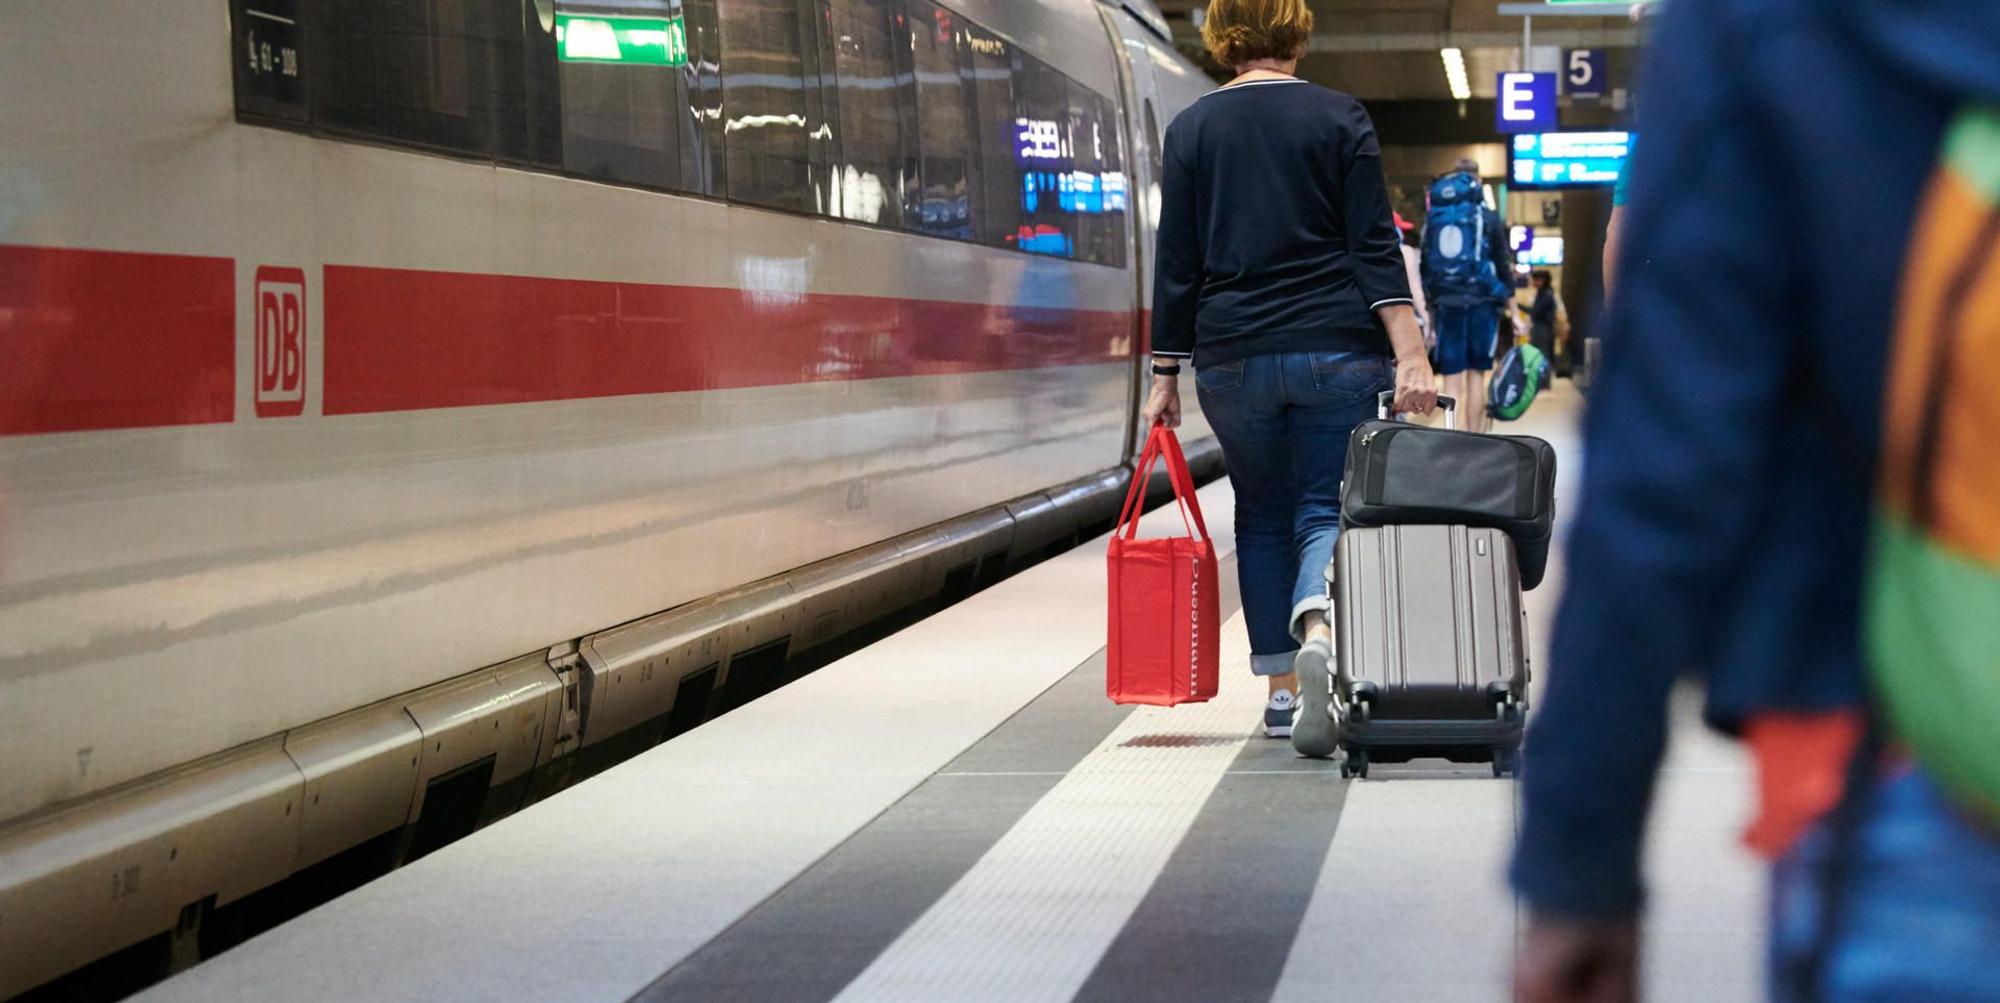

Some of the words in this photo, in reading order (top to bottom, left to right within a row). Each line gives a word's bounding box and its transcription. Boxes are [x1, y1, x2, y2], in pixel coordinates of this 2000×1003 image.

[1569, 50, 1592, 85] 5
[1503, 72, 1535, 120] E
[1510, 226, 1527, 250] F
[262, 291, 300, 391] DB
